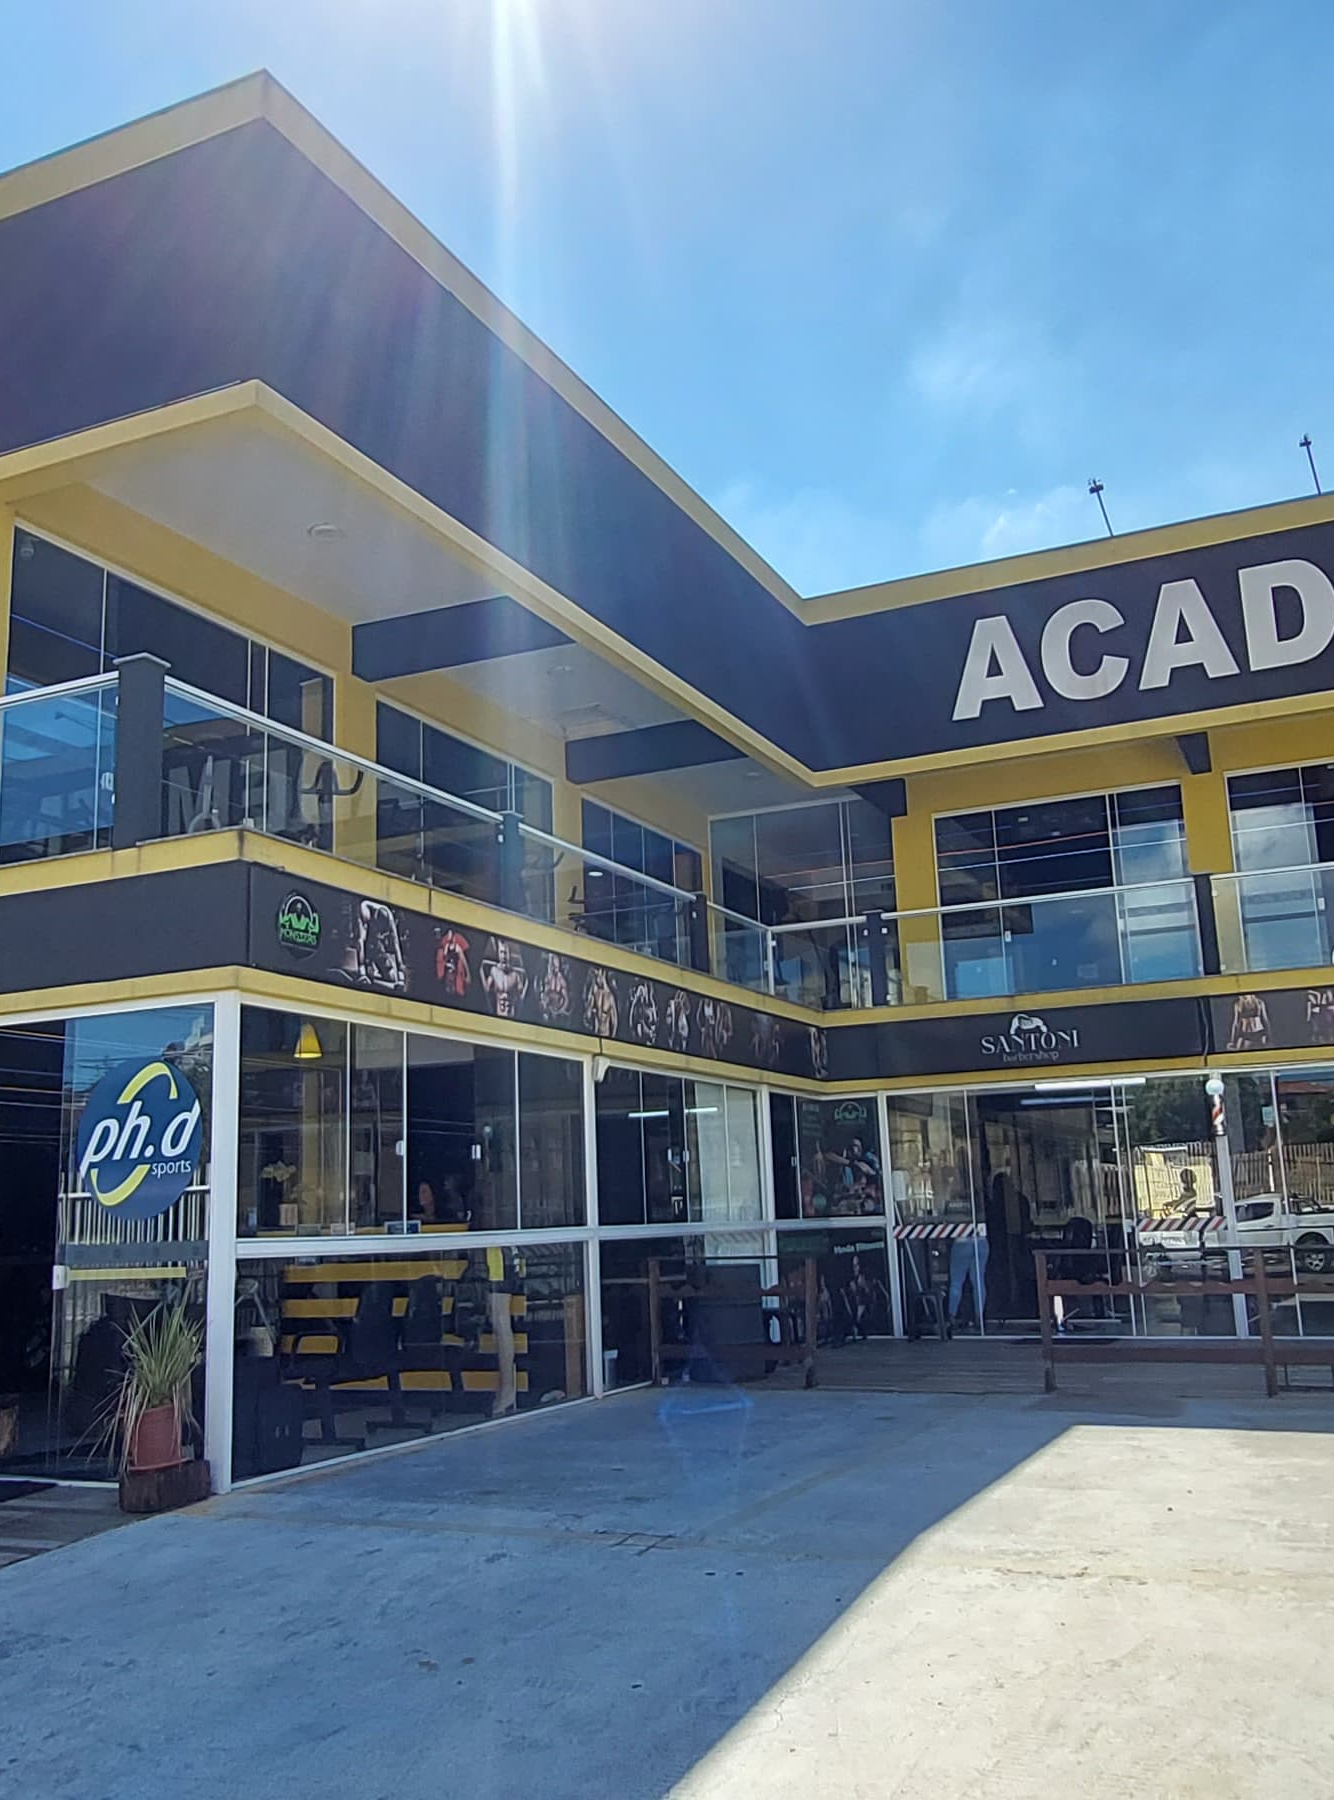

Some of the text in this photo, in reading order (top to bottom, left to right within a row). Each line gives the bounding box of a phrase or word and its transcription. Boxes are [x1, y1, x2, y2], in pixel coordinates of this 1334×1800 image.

[981, 1029, 1079, 1055] SANTONI
[79, 1098, 201, 1179] ph.d
[151, 1160, 192, 1179] sports
